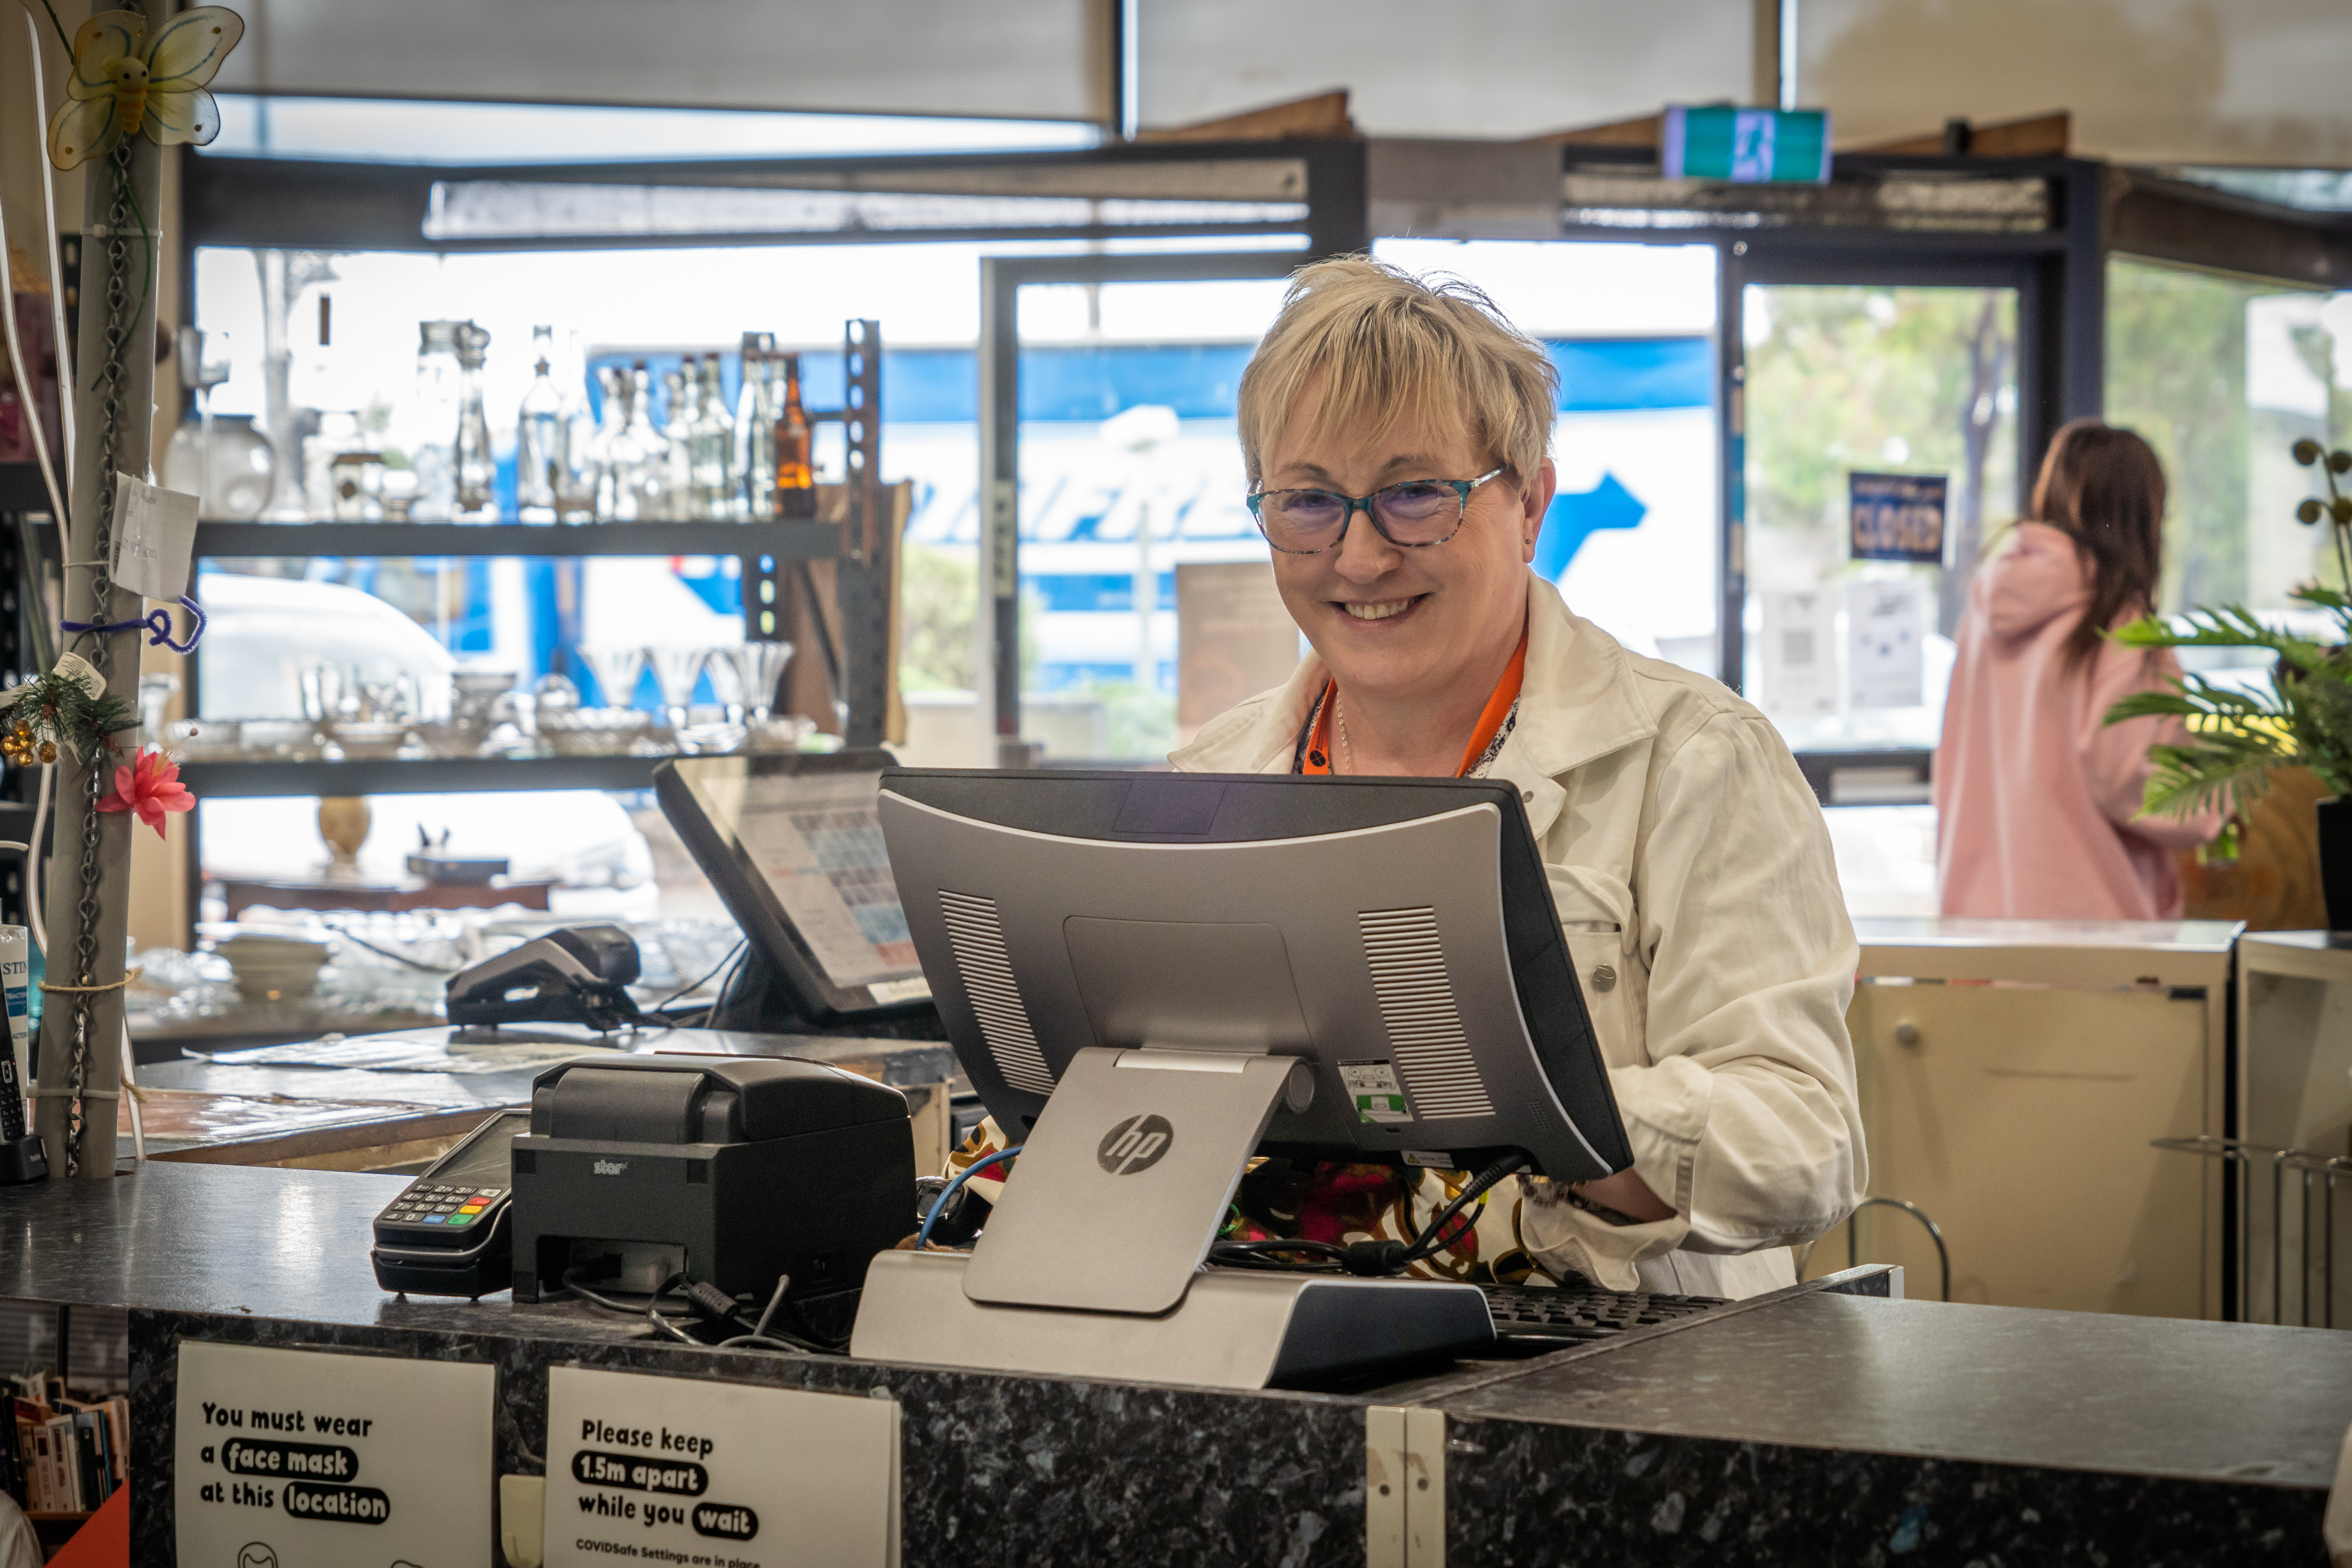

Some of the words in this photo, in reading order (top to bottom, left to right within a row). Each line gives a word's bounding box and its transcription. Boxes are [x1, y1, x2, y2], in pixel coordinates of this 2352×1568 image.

[0, 961, 27, 975] STIN
[1102, 1114, 1171, 1176] hp
[593, 1159, 626, 1175] star
[201, 1401, 243, 1427] You
[250, 1410, 305, 1432] must
[313, 1416, 373, 1437] wear
[581, 1419, 653, 1448] Please
[660, 1427, 714, 1461] keep
[200, 1446, 214, 1464] a
[229, 1443, 280, 1470] face
[287, 1450, 348, 1475] mask
[581, 1455, 626, 1482] 1.5m
[632, 1464, 698, 1492] apart
[200, 1481, 225, 1503] at
[232, 1483, 274, 1508] this
[289, 1485, 387, 1518] location
[578, 1492, 636, 1519] while
[643, 1503, 685, 1528] you
[698, 1510, 750, 1534] wait
[575, 1538, 639, 1557] COVIDSafe
[641, 1546, 690, 1565] Settings
[691, 1555, 712, 1566] are
[714, 1555, 726, 1567] in
